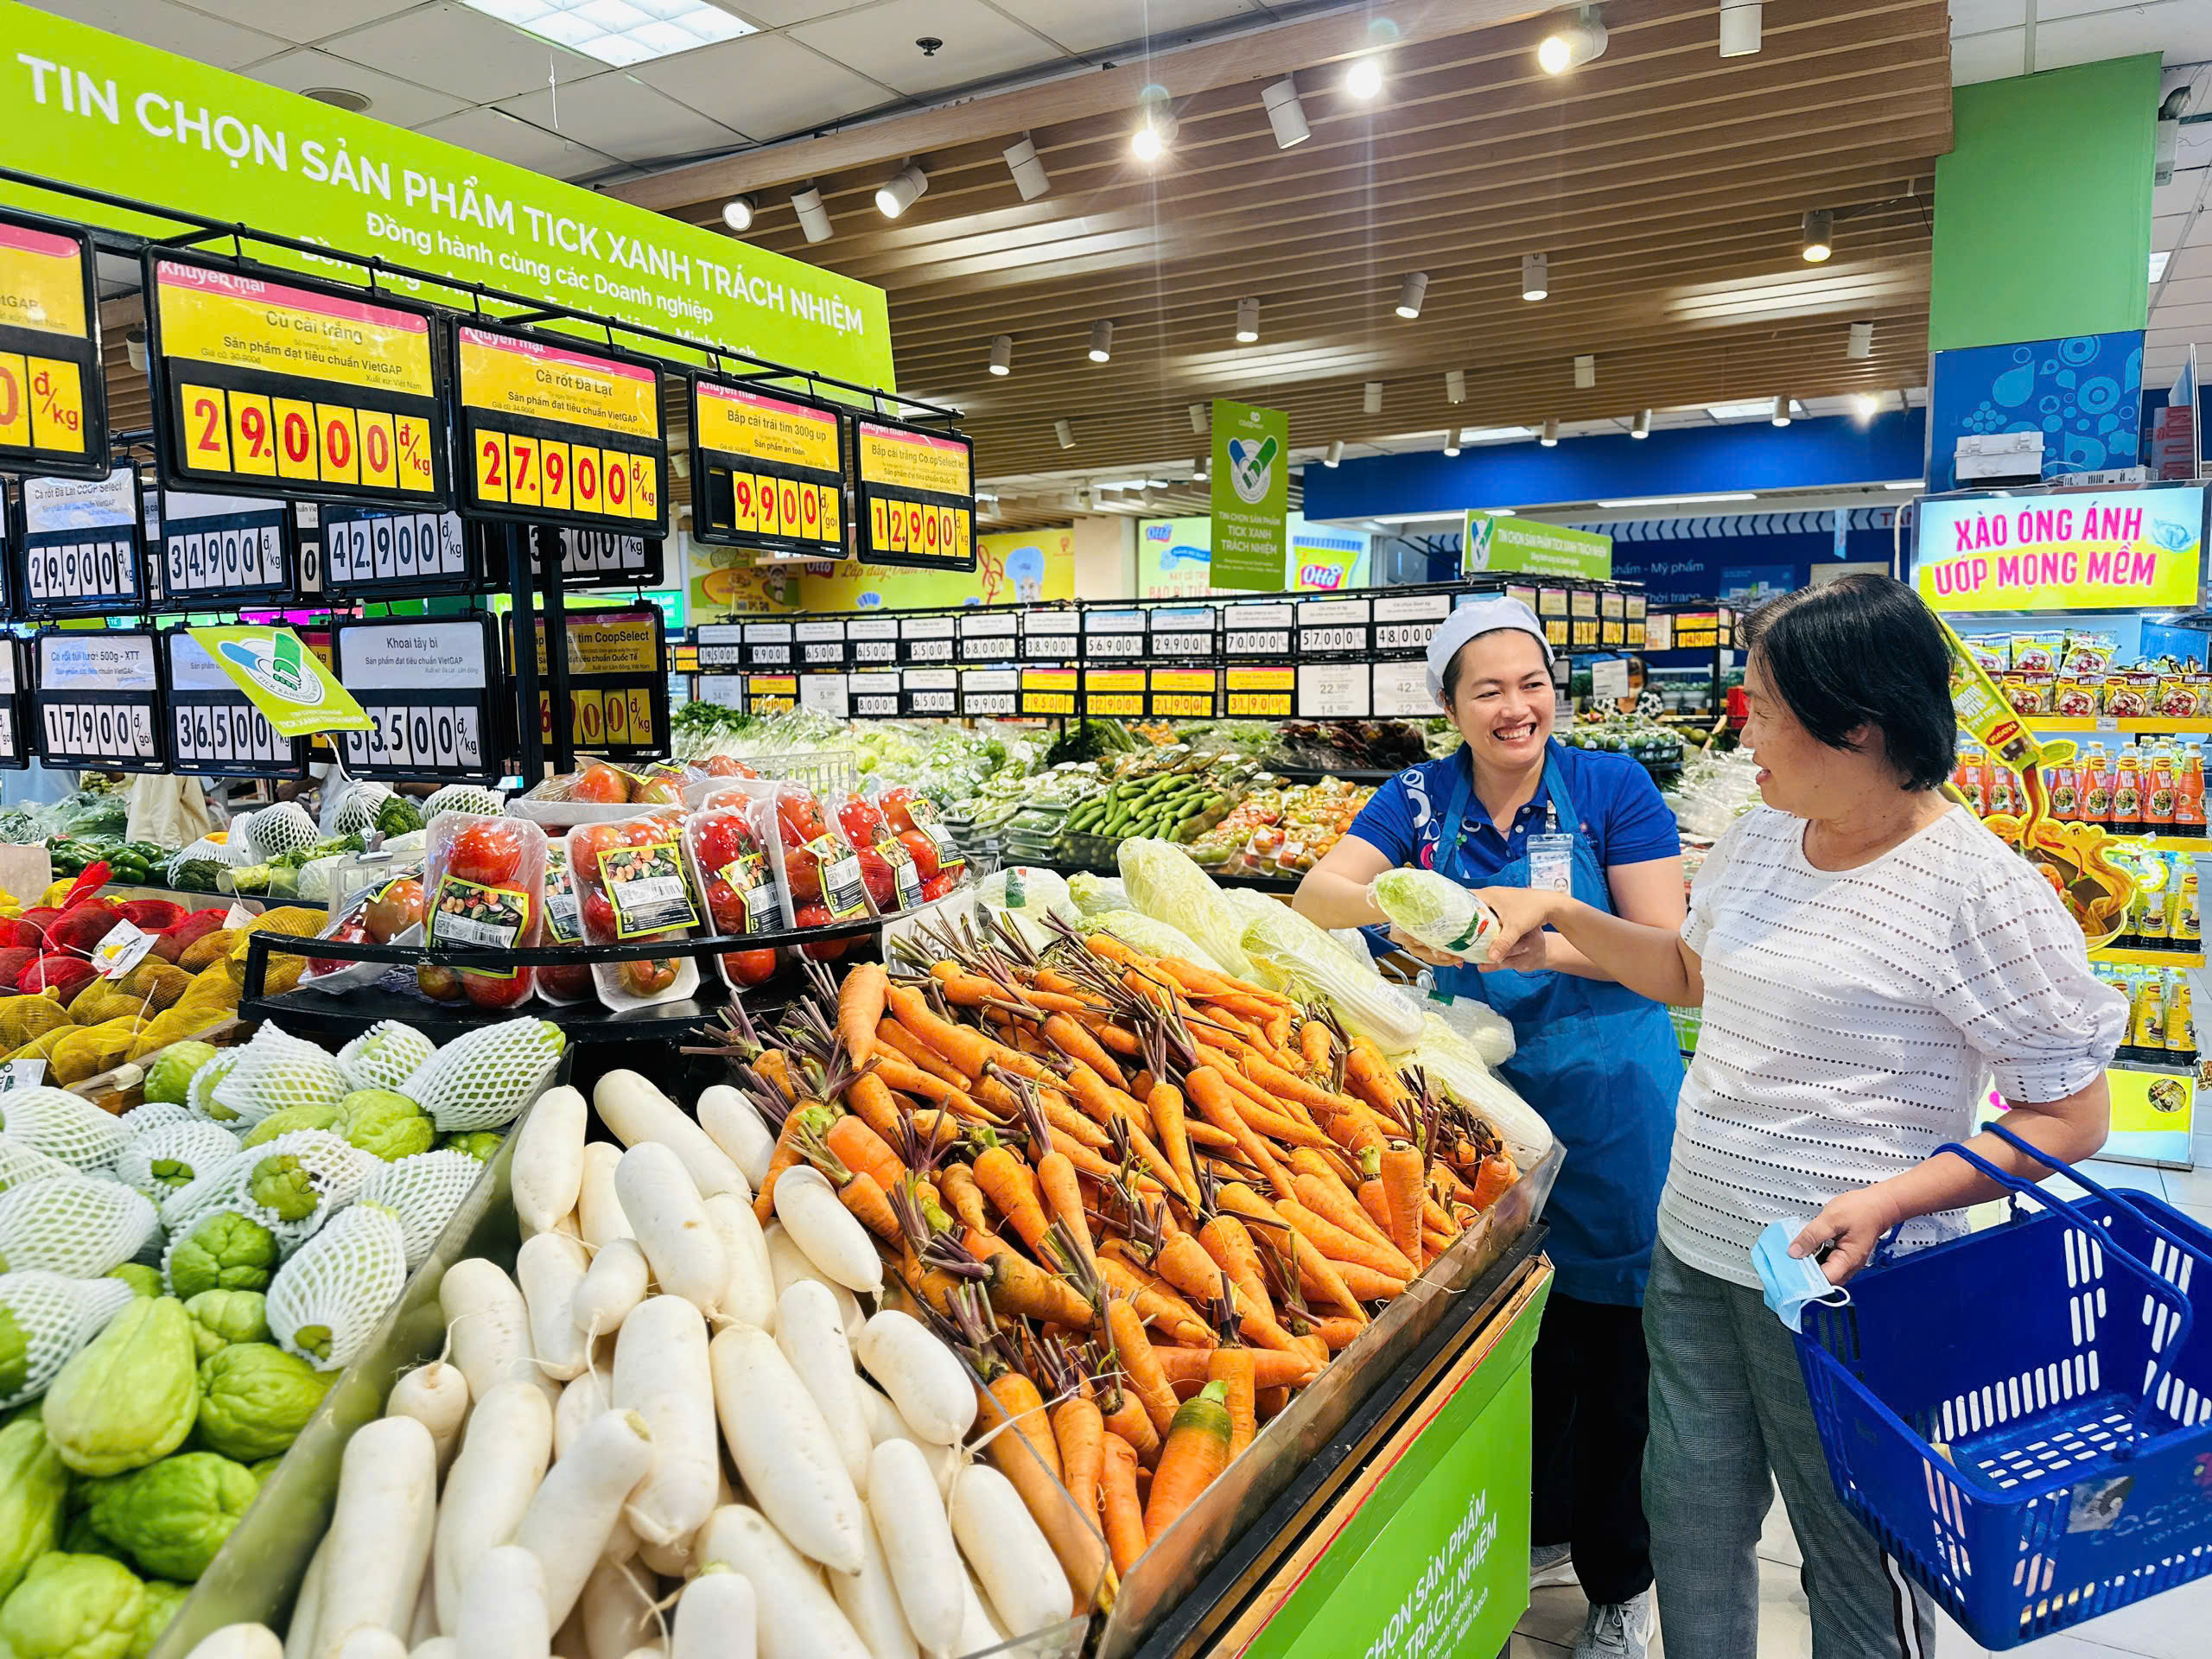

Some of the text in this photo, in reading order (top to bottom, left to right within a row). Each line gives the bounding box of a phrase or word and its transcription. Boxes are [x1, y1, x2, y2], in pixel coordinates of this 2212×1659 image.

[17, 53, 864, 336] TIN CHỌN SẢN PHẨM TICK XANH TRÁCH NHIỆM
[366, 211, 432, 255] Đồng
[437, 231, 493, 263] hành
[499, 251, 551, 286] cùng
[556, 267, 589, 290] các
[594, 273, 652, 306] Doanh
[657, 294, 713, 326] nghiệp
[224, 336, 403, 376] Sản phẩm đạt tiêu chuẩn VietGAP
[536, 369, 552, 385] Cà
[508, 391, 524, 402] Sản
[526, 395, 550, 408] phẩm
[551, 401, 564, 411] đạt
[566, 404, 582, 414] tiêu
[582, 406, 607, 419] chuẩn
[607, 410, 638, 423] VietGAP
[728, 410, 746, 424] Bắp
[779, 423, 793, 434] tim
[794, 425, 814, 440] 300g
[194, 398, 430, 476] 29.000 đ/kg
[483, 442, 655, 506] 27.900 đ/kg
[737, 481, 816, 524] 9.900
[876, 507, 952, 546] 12.900
[1228, 524, 1272, 539] TICK XANH
[1954, 501, 2143, 551] XÀO ÓNG ÁNH
[171, 537, 254, 579] 34.900
[334, 524, 432, 568] 42.900
[1221, 539, 1249, 553] TRÁCH
[1251, 542, 1277, 556] NHIỆM
[31, 552, 112, 589] 29.900
[1303, 565, 1338, 587] Otto
[1650, 563, 1668, 575] Mỹ
[1671, 560, 1704, 575] phẩm
[1935, 551, 1988, 595] ƯỚP
[1998, 550, 2078, 590] MỌNG
[386, 638, 412, 649] Khoai
[414, 639, 427, 651] tây
[578, 631, 650, 644] tim CoopSelect
[100, 651, 139, 663] 500g XTT
[49, 711, 129, 744] 17.900
[180, 713, 267, 748] 36.500
[1415, 1546, 1445, 1611] SẢN
[1449, 1488, 1486, 1566] PHẨM
[1405, 1511, 1497, 1659] TRÁCH NHIỆM
